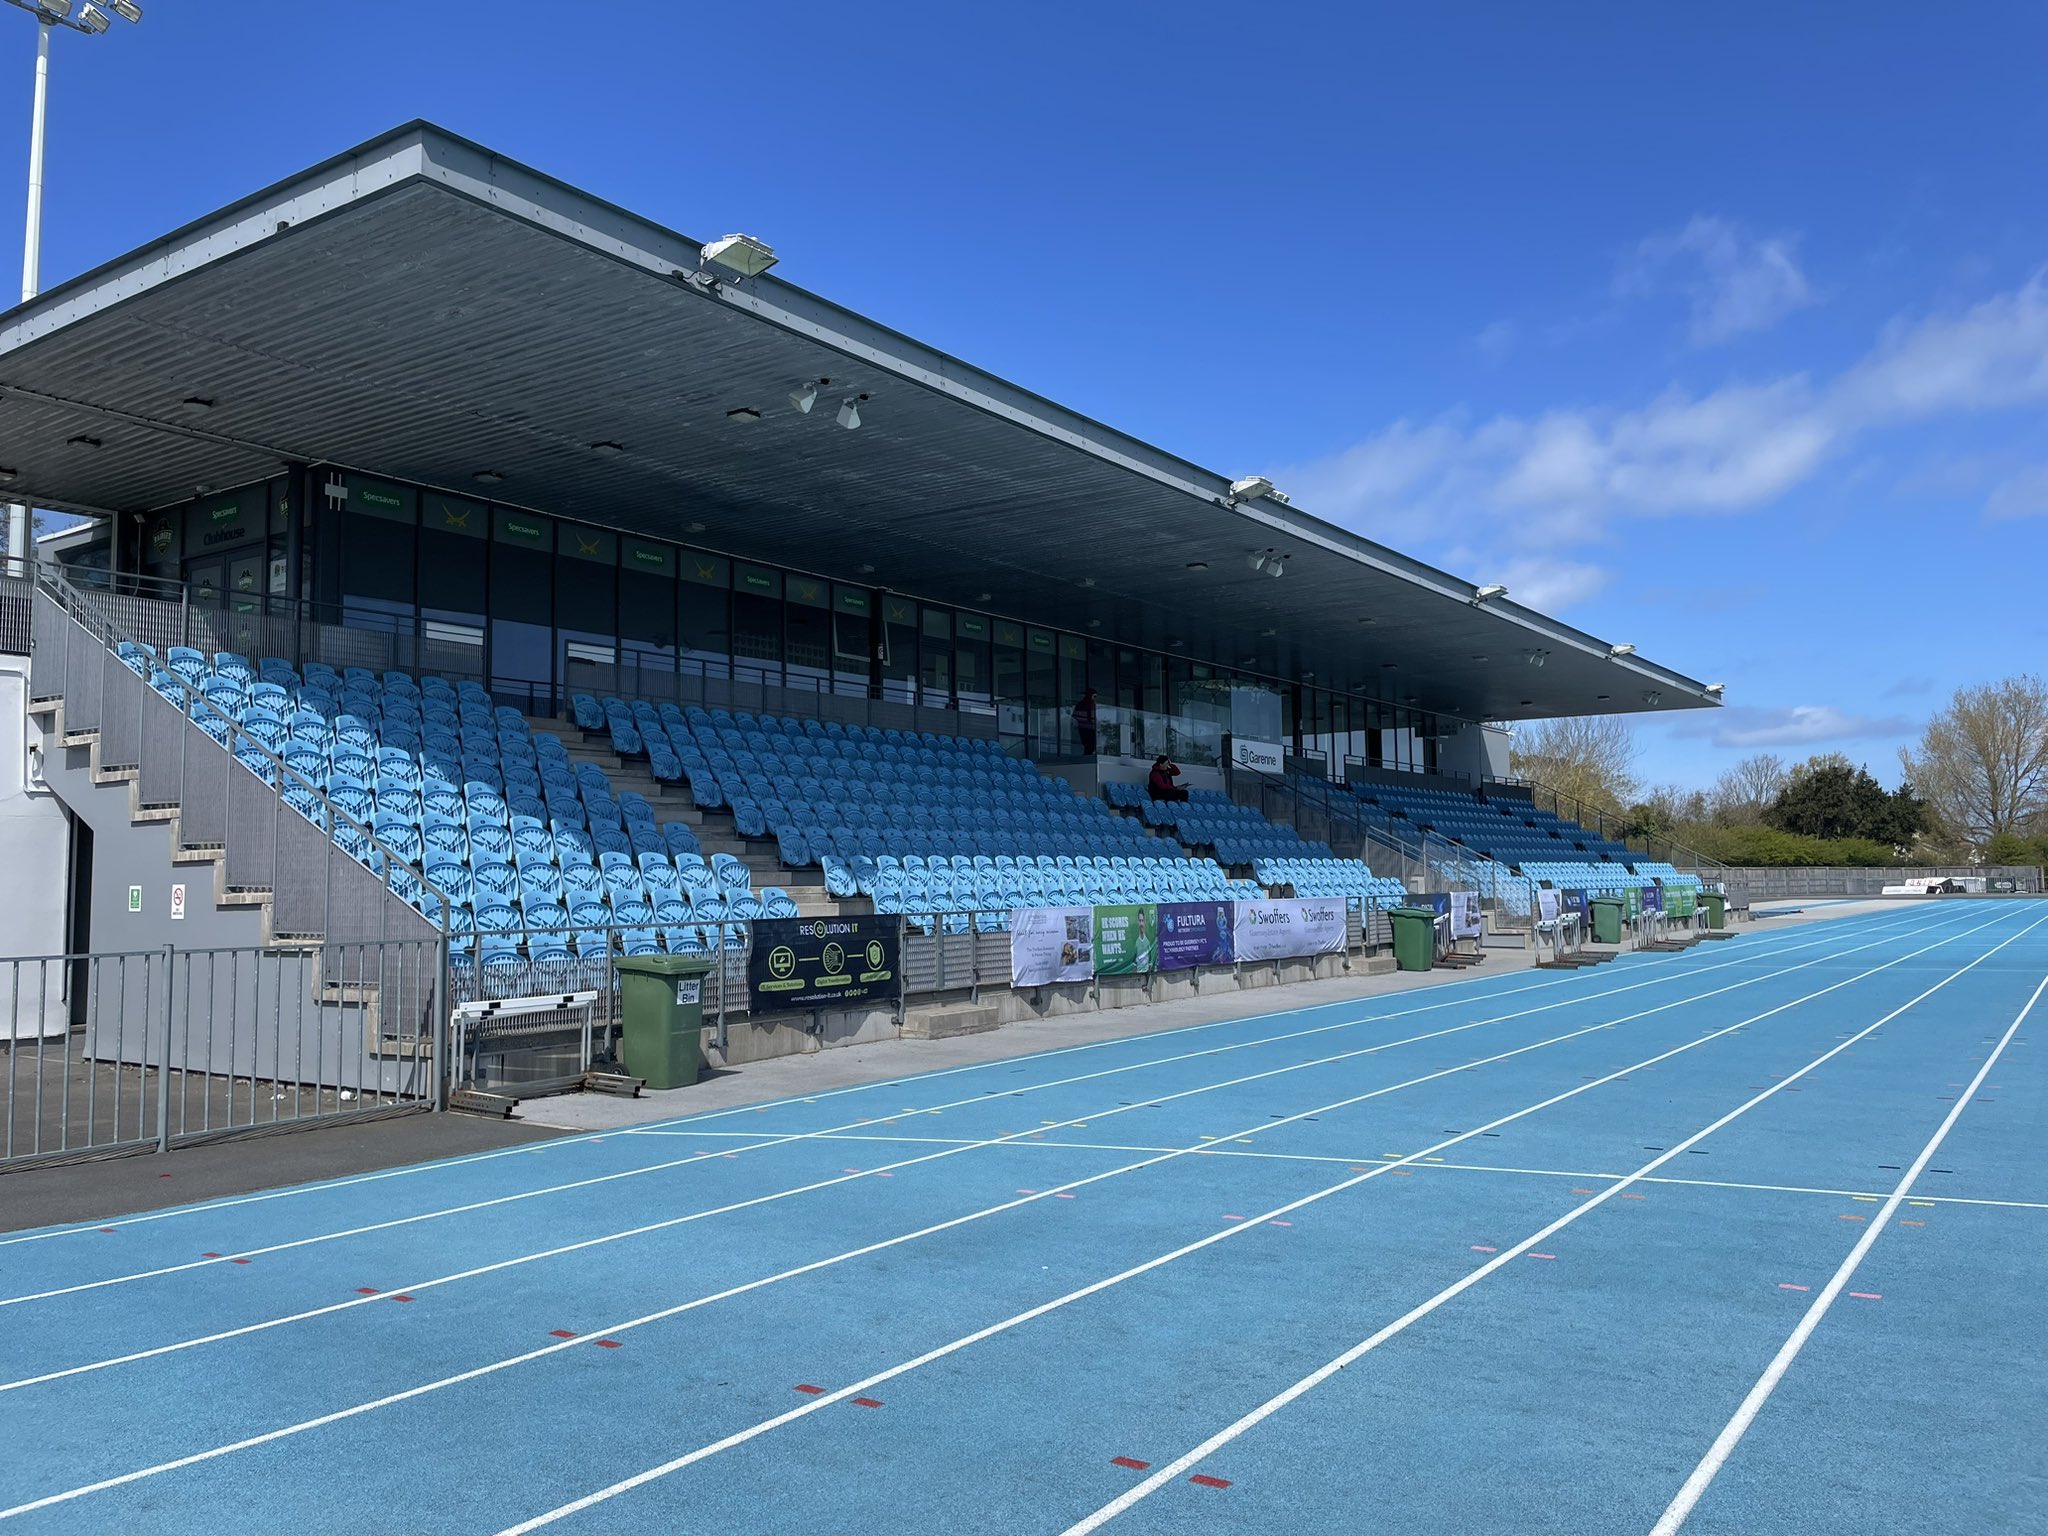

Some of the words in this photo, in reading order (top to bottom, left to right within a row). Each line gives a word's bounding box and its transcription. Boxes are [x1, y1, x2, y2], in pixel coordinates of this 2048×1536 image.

[363, 491, 401, 507] Specsavers
[203, 527, 245, 546] Clubhouse
[508, 522, 540, 537] Specsavers
[1248, 751, 1276, 766] Garenne
[1177, 914, 1206, 927] FULTURA
[1258, 908, 1290, 924] Swoffers
[1308, 907, 1334, 922] Swoffers
[851, 923, 859, 933] IT
[679, 981, 699, 992] Litter
[682, 994, 695, 1003] Bin
